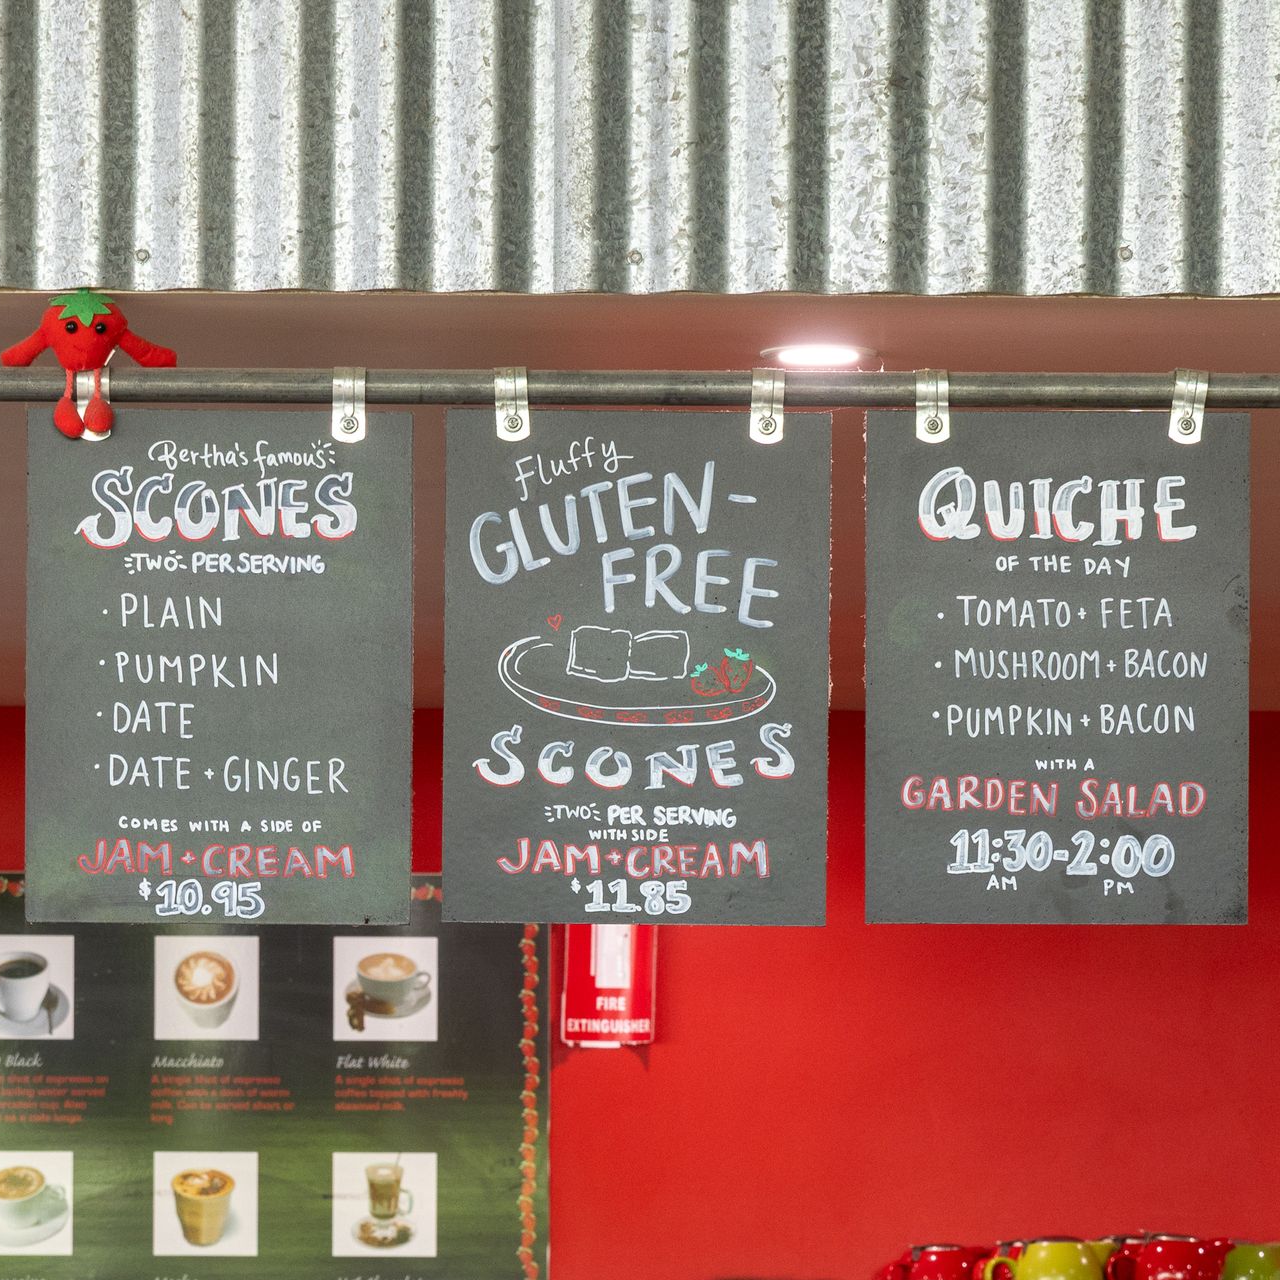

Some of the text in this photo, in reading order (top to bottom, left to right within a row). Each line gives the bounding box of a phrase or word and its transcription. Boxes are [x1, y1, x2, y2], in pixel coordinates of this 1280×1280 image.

[148, 440, 249, 470] Bertha's
[514, 435, 634, 501] Fluffy
[74, 466, 359, 549] SCONES
[918, 466, 1198, 546] QUICHE
[132, 553, 326, 575] TWO PER SERVING
[995, 556, 1131, 577] OF THE DAY
[602, 543, 779, 628] FREE
[121, 593, 222, 630] PLAIN
[956, 595, 1072, 628] TOMATO
[1101, 597, 1173, 629] FETA
[115, 651, 278, 688] PUMPKIN
[954, 648, 1101, 680] MUSHROOM
[1125, 648, 1208, 680] BACON
[113, 701, 194, 739] DATE
[947, 704, 1072, 738] PUMPKIN
[1100, 704, 1195, 735] BACON
[473, 723, 795, 790] SCONES
[1036, 758, 1095, 771] WITH A
[109, 754, 191, 790] DATE
[223, 756, 349, 795] GINGER
[901, 775, 1207, 819] GARDEN SALAD
[118, 816, 322, 833] COMES WITH A SIDE OF
[553, 805, 737, 828] TWO PER SERVING
[589, 828, 669, 843] WITH SIDE
[139, 878, 266, 919] $10.95
[571, 878, 692, 914] $11.85
[986, 875, 1134, 895] AM PM
[596, 997, 626, 1011] FIRE
[567, 1018, 650, 1033] EXTINGUISHER
[5, 1052, 43, 1067] Black
[151, 1053, 224, 1068] Macchiato
[336, 1054, 410, 1069] Flat White
